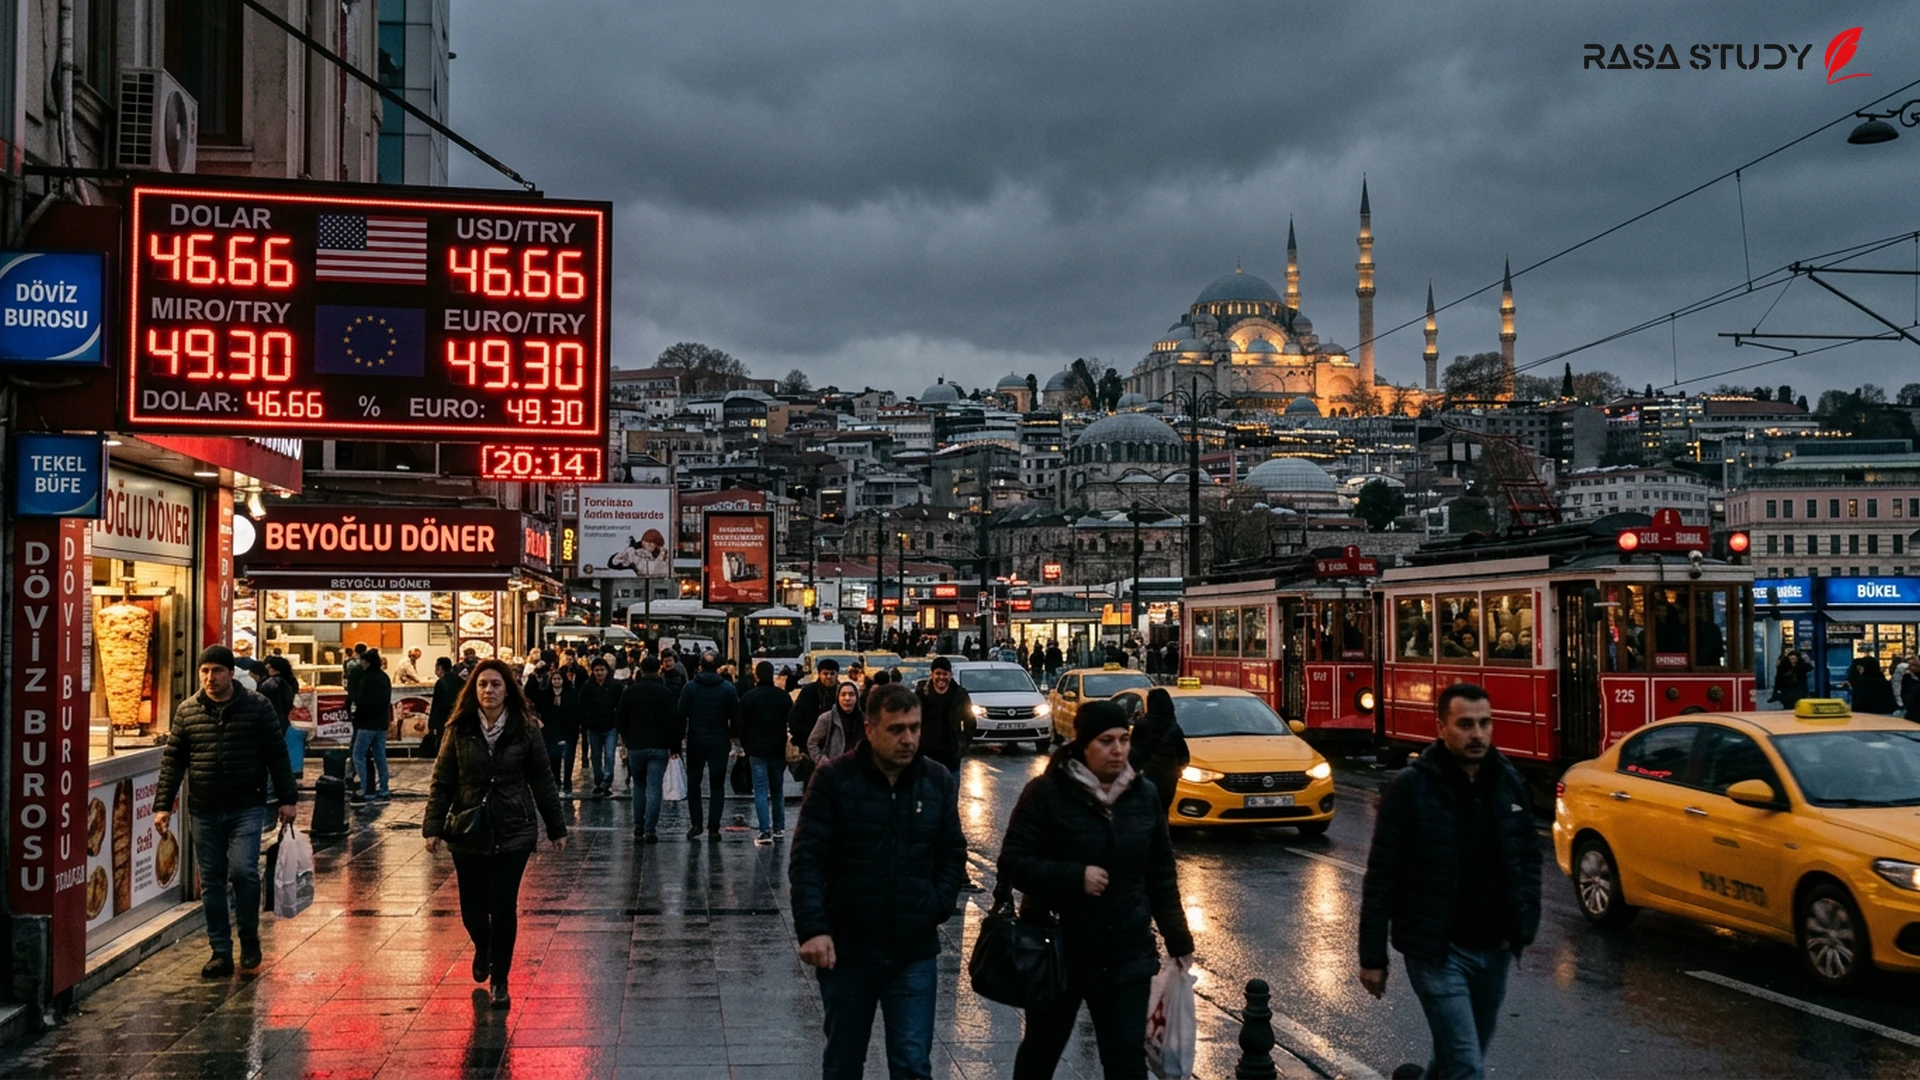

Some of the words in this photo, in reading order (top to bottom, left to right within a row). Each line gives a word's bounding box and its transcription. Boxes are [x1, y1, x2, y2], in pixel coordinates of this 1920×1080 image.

[170, 203, 272, 230] DOLAR
[456, 217, 576, 244] USD/TRY
[150, 234, 294, 288] 46.66
[449, 247, 585, 300] 46.66
[15, 279, 78, 304] DÖVİZ
[4, 308, 88, 329] BUROSU
[151, 297, 291, 324] MIRO/TRY
[443, 308, 586, 335] EURO/TRY
[148, 328, 293, 382] 49.30
[447, 339, 584, 391] 49.30
[142, 389, 239, 413] DOLAR:
[246, 390, 324, 418] 46.66
[358, 395, 382, 417] %
[409, 397, 486, 419] EURO:
[507, 398, 584, 426] 49.30
[30, 454, 87, 472] TEKEL
[493, 450, 585, 476] 20:14
[34, 473, 82, 494] BÜFE
[146, 490, 190, 546] DÖNER
[264, 515, 393, 551] BEYOĞLU
[401, 517, 496, 553] DÖNER
[1856, 582, 1901, 598] BÜKEL
[22, 541, 51, 692] DÖVİZ
[1614, 689, 1636, 704] 225
[59, 674, 74, 861] BUROSU
[19, 709, 48, 891] BUROSU
